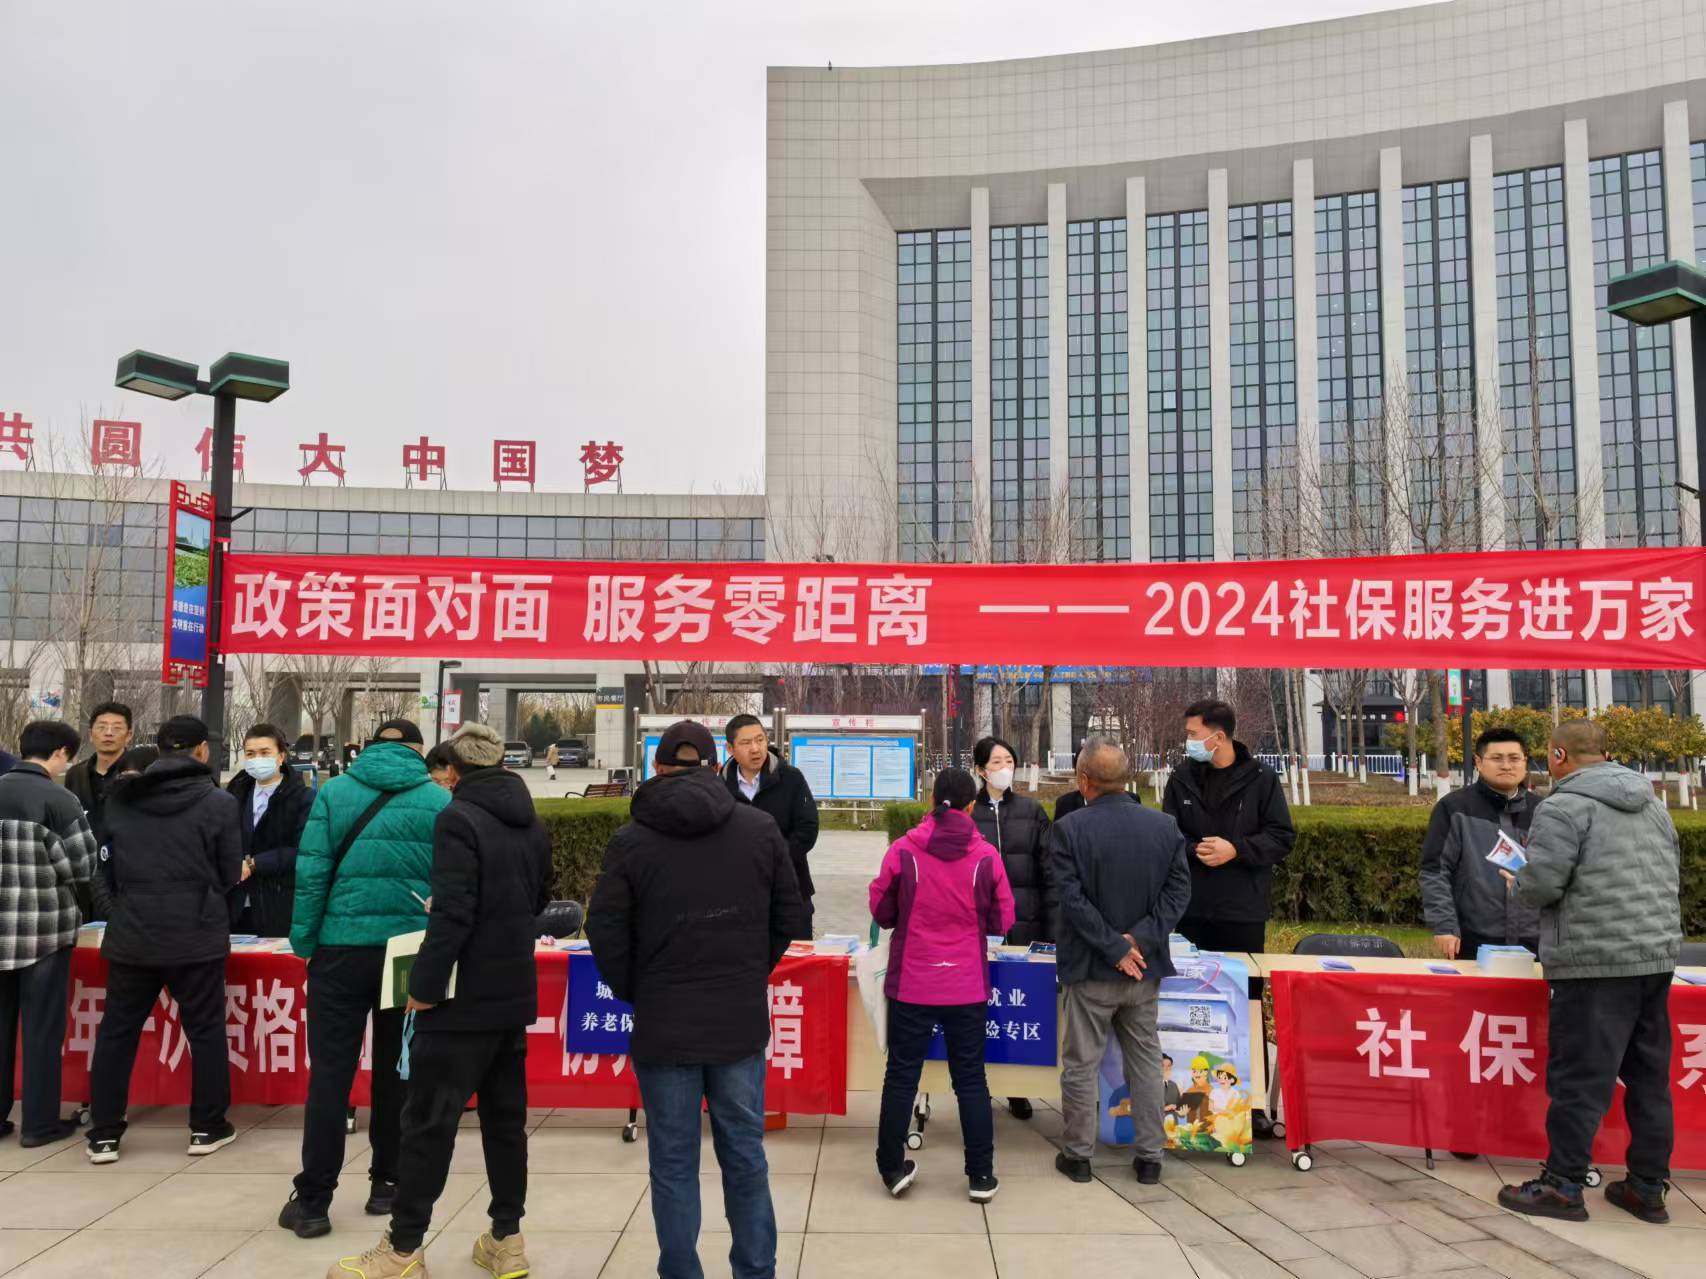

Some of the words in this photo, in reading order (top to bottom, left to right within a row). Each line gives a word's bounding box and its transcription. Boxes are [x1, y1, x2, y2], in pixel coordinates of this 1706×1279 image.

[231, 571, 553, 643] 政策面对面
[583, 574, 933, 648] 服务零距离
